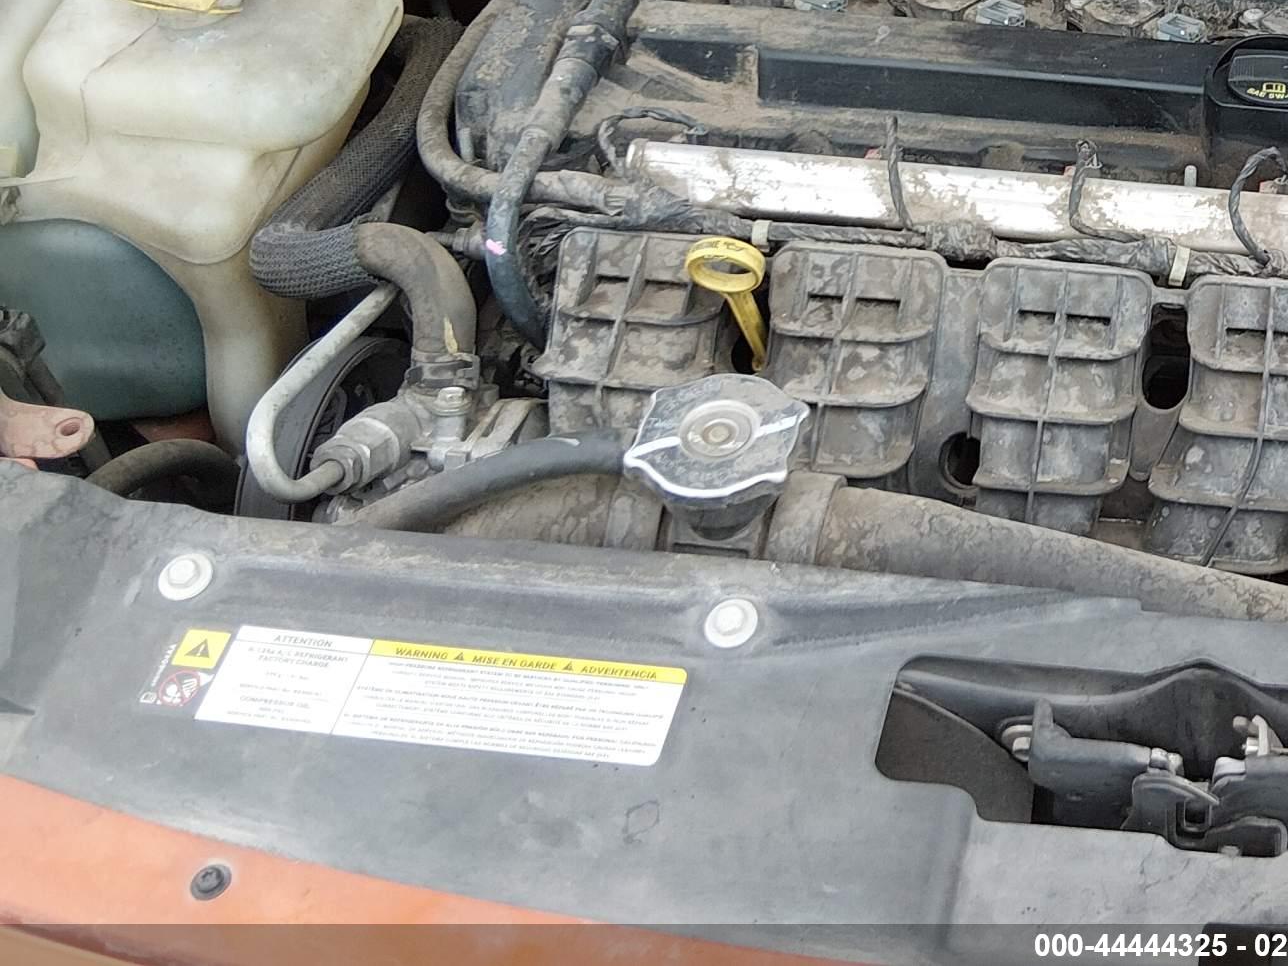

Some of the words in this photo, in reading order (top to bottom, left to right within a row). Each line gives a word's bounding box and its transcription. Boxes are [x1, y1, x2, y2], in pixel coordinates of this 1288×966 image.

[273, 634, 334, 648] ATTENTION
[395, 646, 448, 660] WARNING
[472, 655, 501, 665] MISE
[501, 658, 517, 667] EN
[519, 659, 556, 671] GARDE
[580, 665, 657, 679] ADVERTENCIA
